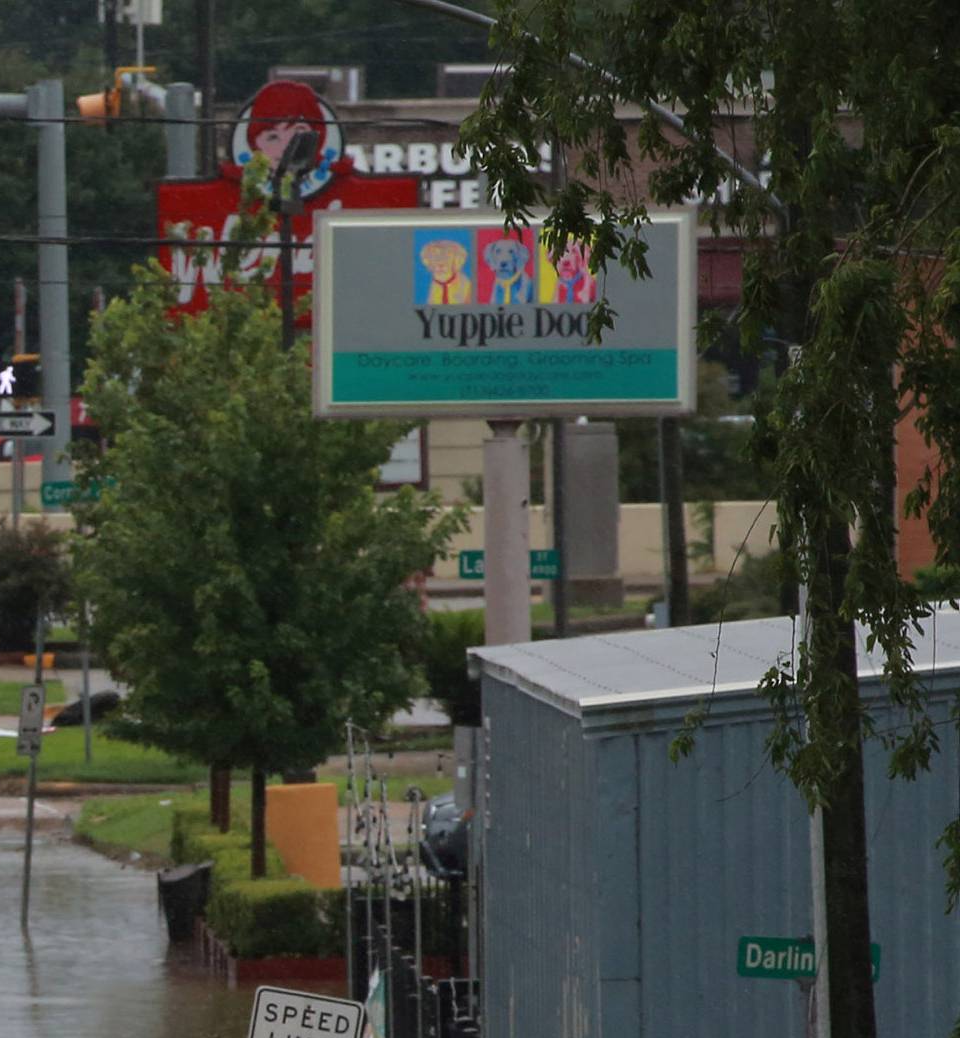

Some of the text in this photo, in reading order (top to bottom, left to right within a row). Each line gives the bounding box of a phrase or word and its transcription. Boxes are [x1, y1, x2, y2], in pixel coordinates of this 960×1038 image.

[415, 307, 525, 347] Yuppie
[617, 350, 652, 368] Spa
[744, 943, 815, 972] Darlin
[264, 1002, 350, 1034] SPEED
